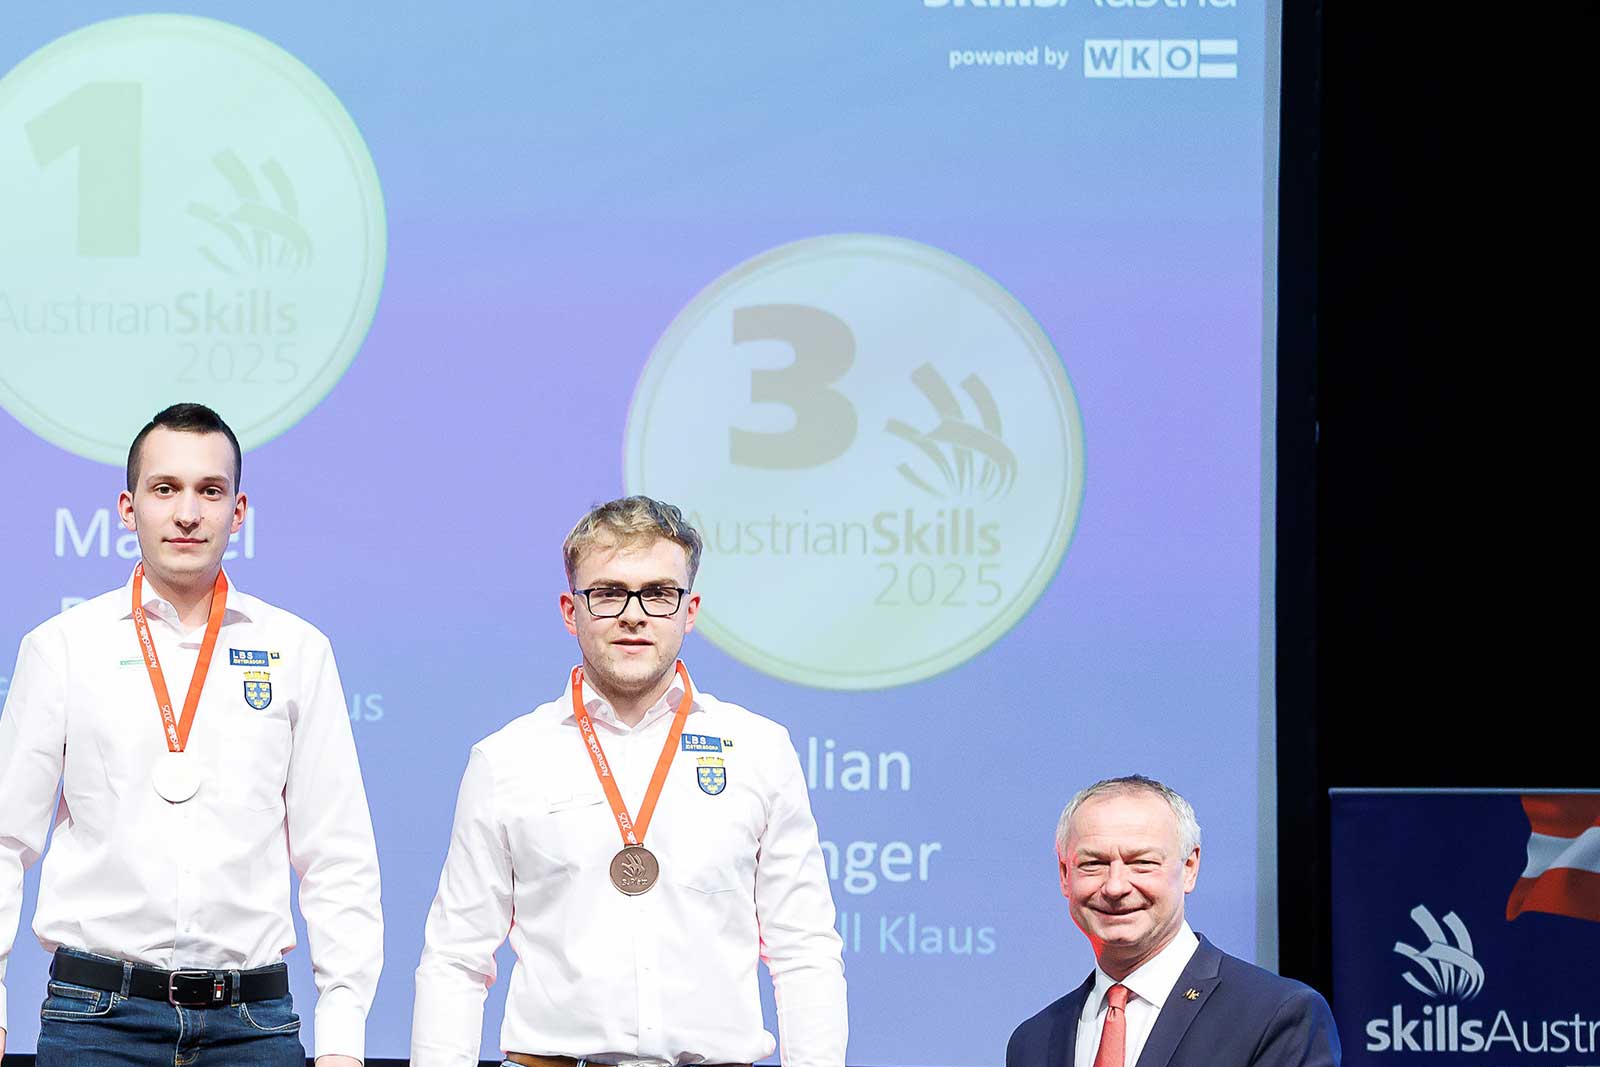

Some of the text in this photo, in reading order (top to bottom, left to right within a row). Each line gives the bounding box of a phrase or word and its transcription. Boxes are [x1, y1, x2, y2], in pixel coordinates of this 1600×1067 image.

[949, 43, 1196, 74] powered by WKO
[24, 81, 143, 258] 1
[176, 342, 298, 384] 2025
[728, 303, 858, 470] 3
[874, 562, 1002, 606] 2025
[232, 650, 254, 660] LBS
[685, 735, 707, 745] LBS
[798, 736, 911, 790] lian
[879, 912, 997, 954] Klaus
[1366, 1003, 1600, 1053] skillsAustr
